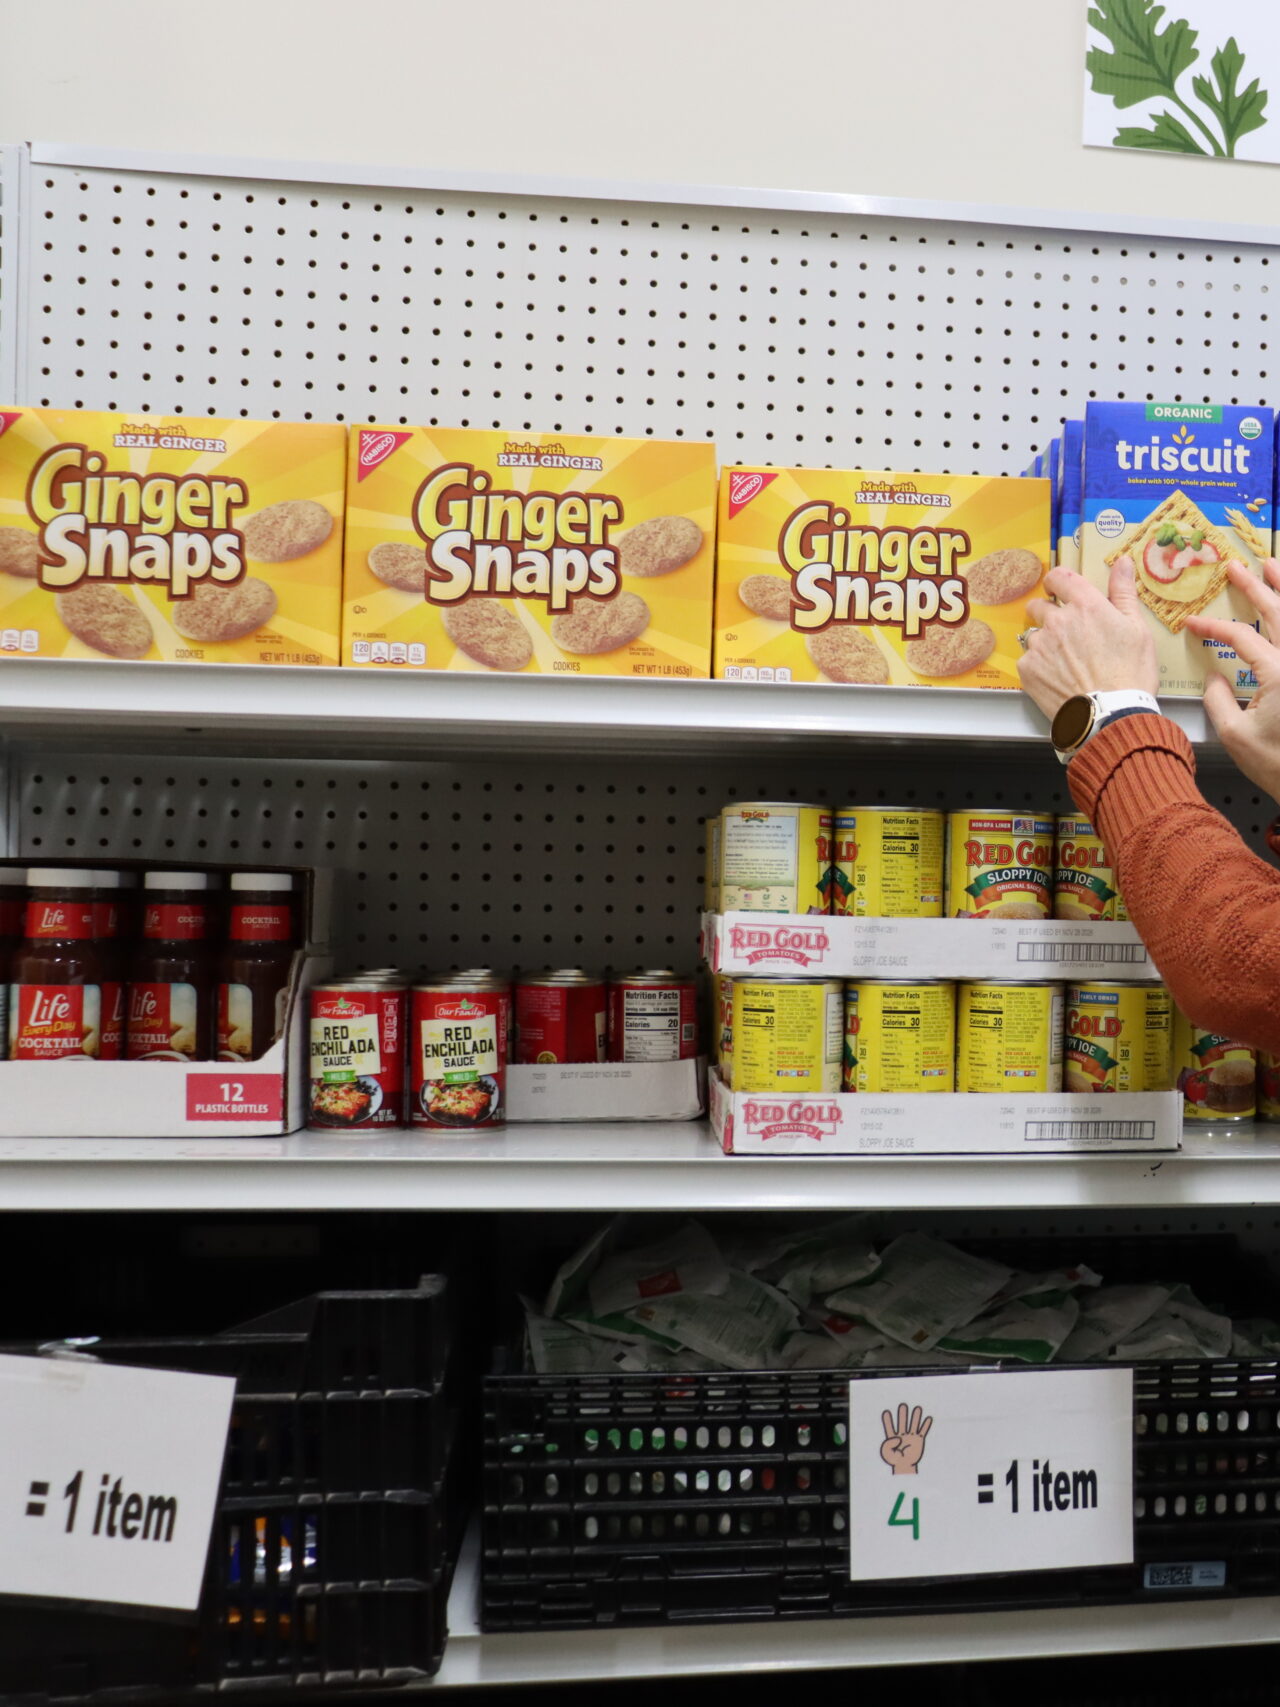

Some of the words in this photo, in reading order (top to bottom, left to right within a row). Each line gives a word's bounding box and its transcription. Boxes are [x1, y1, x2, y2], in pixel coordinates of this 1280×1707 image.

[1154, 407, 1213, 419] ORGANIC
[121, 424, 155, 436] Made
[158, 425, 186, 437] with
[114, 435, 158, 449] REAL
[160, 436, 227, 453] GINGER
[363, 435, 394, 464] NABISCO
[505, 443, 537, 453] Made
[539, 444, 565, 454] with
[1116, 436, 1250, 474] triscuit
[497, 453, 538, 467] REAL
[541, 455, 604, 471] GINGER
[30, 447, 246, 537] Ginger
[733, 476, 761, 503] NABISCO
[861, 482, 890, 492] Made
[891, 483, 916, 493] with
[855, 491, 894, 504] REAL
[895, 493, 950, 507] GINGER
[416, 467, 621, 552] Ginger
[1098, 519, 1122, 528] quality
[783, 505, 968, 582] Ginger
[42, 513, 243, 597] Snaps
[428, 529, 620, 610] Snaps
[793, 562, 966, 636] Snaps
[175, 649, 204, 659] COOKIES
[354, 643, 369, 652] 120
[1218, 651, 1237, 659] sea
[553, 661, 581, 672] COOKIES
[633, 664, 645, 674] NET
[646, 665, 656, 674] WT
[672, 666, 693, 678] (453g)
[906, 817, 919, 825] Facts
[882, 844, 906, 852] Calories
[911, 843, 919, 852] 30
[964, 839, 1014, 868] RED
[1016, 840, 1051, 869] GOL
[857, 874, 866, 883] 30
[987, 868, 1032, 885] SLOPPY
[1033, 871, 1048, 887] JOE
[1074, 873, 1095, 888] JOE
[997, 882, 1025, 892] ORIGINAL
[1026, 884, 1042, 893] SAUCE
[41, 908, 65, 928] Life
[241, 916, 280, 925] COCKTAIL
[1018, 928, 1031, 936] BEST
[1039, 928, 1054, 936] USED
[728, 927, 771, 951] RED
[774, 927, 829, 951] GOLD
[755, 949, 801, 959] TOMATOES
[853, 956, 874, 967] SLOPPY
[875, 956, 888, 967] JOE
[889, 956, 909, 967] SAUCE
[625, 991, 657, 1000] Nutrition
[659, 991, 679, 1000] Facts
[970, 991, 988, 999] Nutrition
[29, 990, 70, 1026] Life
[130, 989, 157, 1021] Life
[454, 1006, 484, 1017] Family
[668, 1018, 678, 1028] 20
[743, 1016, 761, 1024] Calories
[765, 1016, 775, 1025] 30
[882, 1018, 906, 1026] Calories
[911, 1017, 920, 1026] 30
[969, 1017, 989, 1026] Calories
[993, 1017, 1003, 1026] 30
[1068, 1009, 1123, 1037] GOLD
[324, 1025, 349, 1041] RED
[444, 1027, 472, 1042] RED
[19, 1037, 82, 1050] COCKTAIL
[312, 1039, 376, 1056] ENCHILADA
[425, 1038, 495, 1058] ENCHILADA
[1079, 1040, 1097, 1056] JOE
[34, 1048, 63, 1057] SAUCE
[860, 1047, 867, 1056] 30
[1120, 1049, 1130, 1058] 30
[323, 1056, 353, 1067] SAUCE
[444, 1056, 475, 1068] SAUCE
[220, 1083, 244, 1102] 12
[195, 1104, 230, 1113] PLASTIC
[231, 1104, 268, 1114] BOTTLES
[742, 1102, 785, 1125] RED
[787, 1101, 842, 1125] GOLD
[769, 1123, 813, 1133] TOMATOES
[859, 1138, 881, 1148] SLOPPY
[882, 1138, 894, 1148] JOE
[895, 1138, 914, 1148] SAUCE
[978, 1473, 994, 1504] =
[1006, 1459, 1018, 1513] 1
[1032, 1459, 1098, 1512] item
[25, 1481, 50, 1517] =
[64, 1470, 83, 1533] 1
[92, 1473, 177, 1542] item
[887, 1491, 920, 1541] 4
